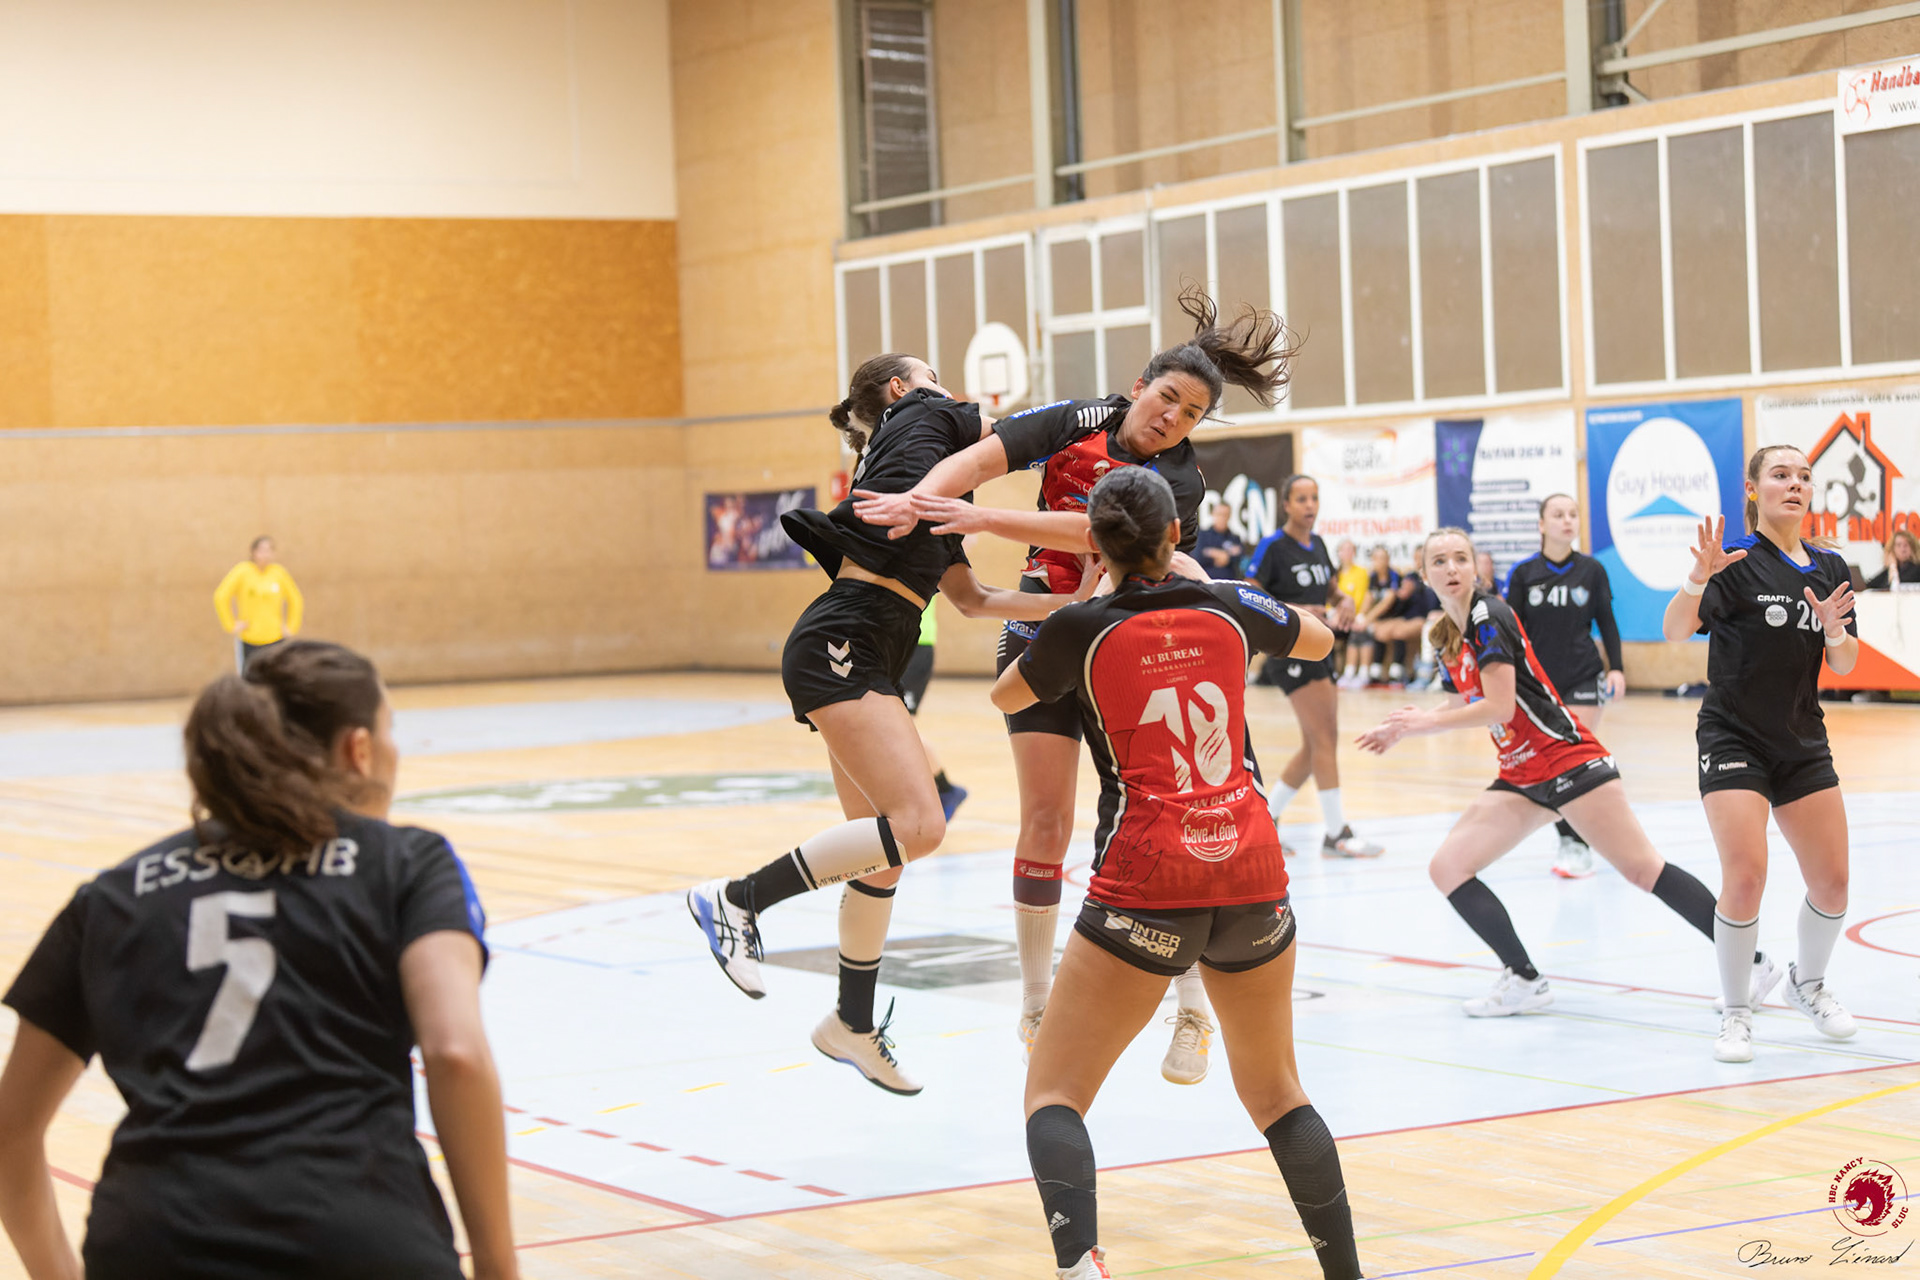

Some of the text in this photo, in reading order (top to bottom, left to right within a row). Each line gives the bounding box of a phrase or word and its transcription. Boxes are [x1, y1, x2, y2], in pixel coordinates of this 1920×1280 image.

[1614, 469, 1710, 496] Guy Hoquet
[1547, 585, 1569, 607] 41
[1757, 594, 1786, 603] CRAFT
[1139, 646, 1204, 667] AU BUREAU
[1184, 824, 1208, 844] Cave
[1213, 821, 1239, 842] Léon
[1128, 932, 1178, 959] SPORT
[1133, 922, 1181, 948] INTER
[184, 889, 277, 1072] 5
